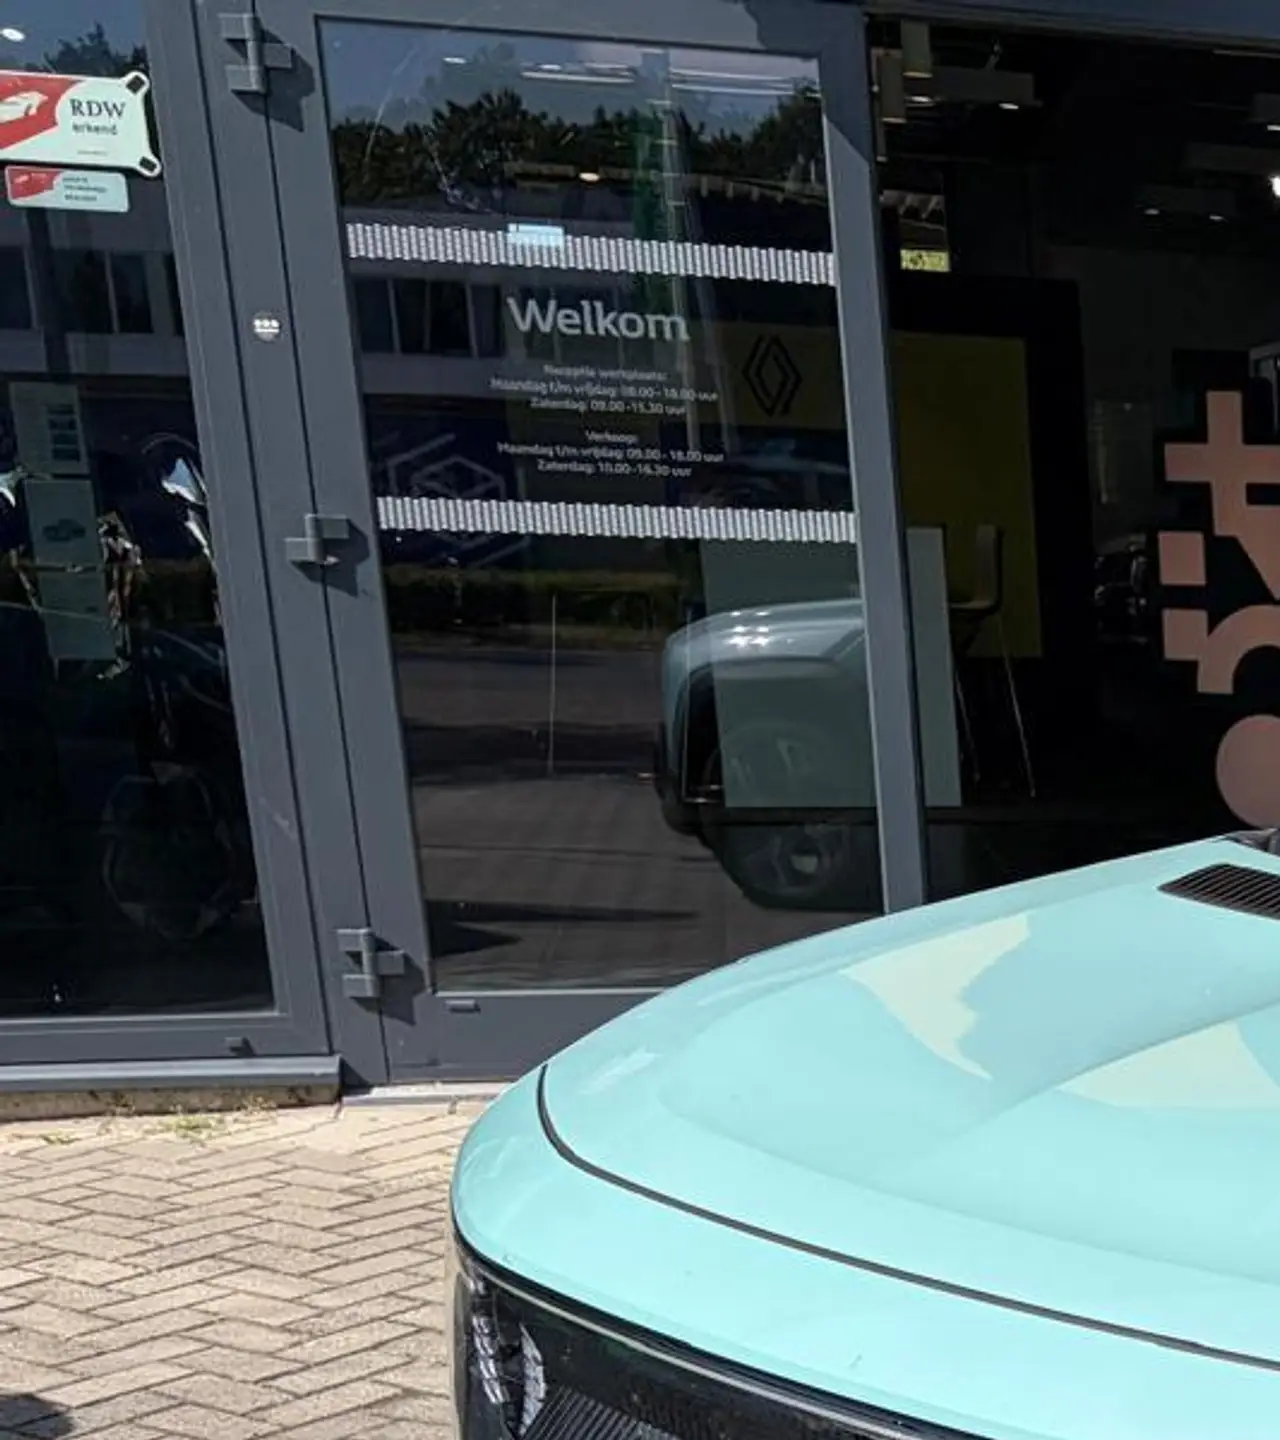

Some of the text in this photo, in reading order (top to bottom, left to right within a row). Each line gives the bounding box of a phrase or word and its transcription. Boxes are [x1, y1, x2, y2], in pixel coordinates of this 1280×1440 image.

[70, 98, 126, 119] RDW
[506, 297, 689, 342] Welkom
[490, 376, 548, 395] Maandag
[698, 391, 718, 401] uur
[665, 405, 686, 416] uur
[497, 441, 553, 458] Maandag
[703, 453, 724, 463] uur
[672, 467, 692, 478] uur
